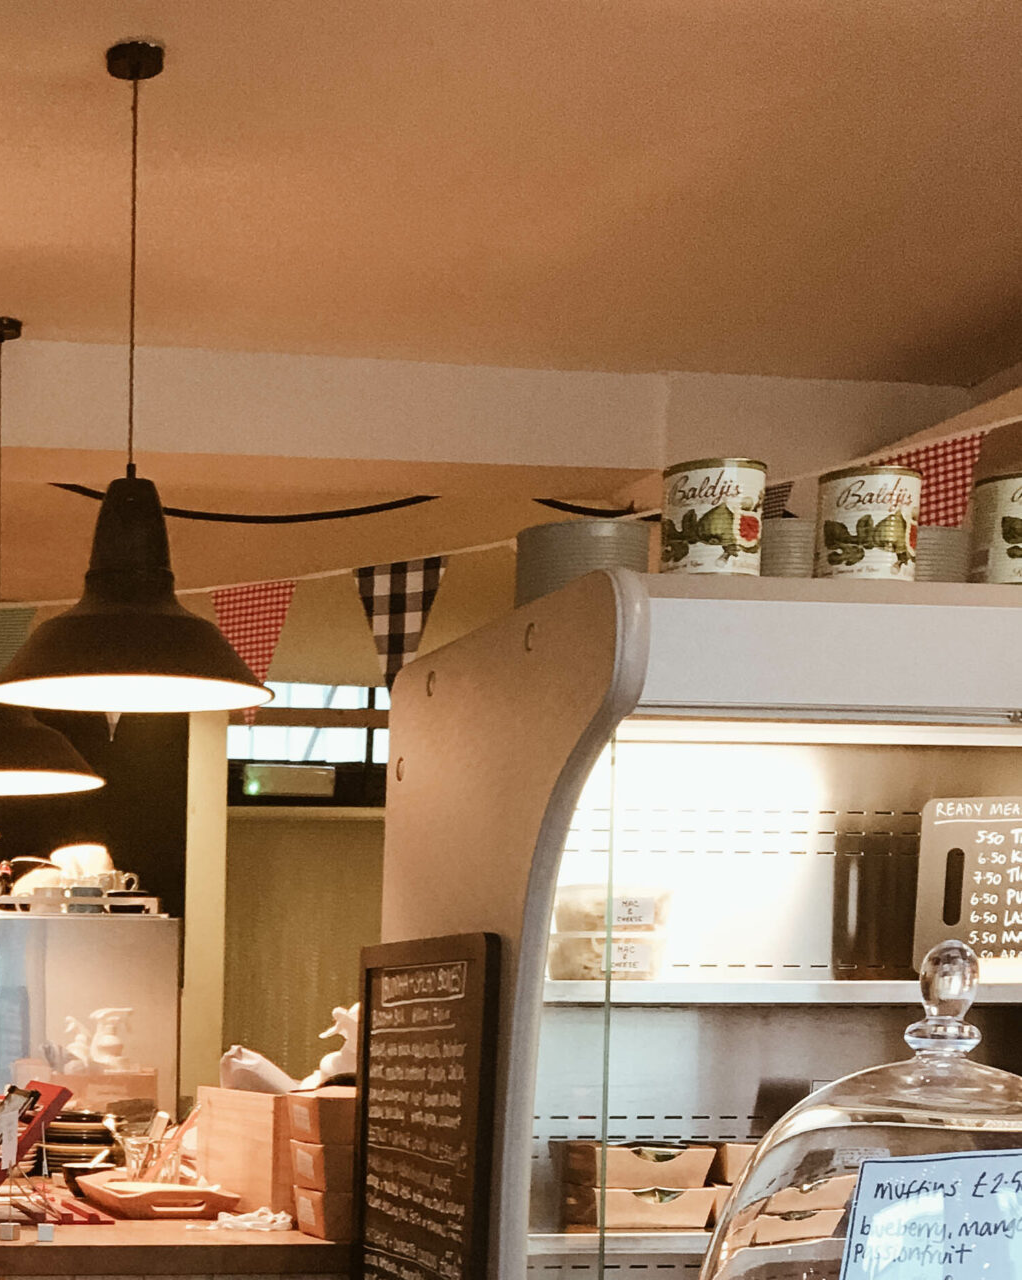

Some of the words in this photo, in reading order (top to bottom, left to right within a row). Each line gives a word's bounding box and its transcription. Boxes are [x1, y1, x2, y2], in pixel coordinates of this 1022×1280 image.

[936, 803, 983, 817] READY
[989, 803, 1022, 816] MEA
[970, 892, 998, 905] 6.50
[970, 911, 998, 924] 6.50
[968, 930, 997, 945] 5.50
[972, 1170, 1022, 1197] £2.5
[860, 1216, 952, 1243] bueberry,
